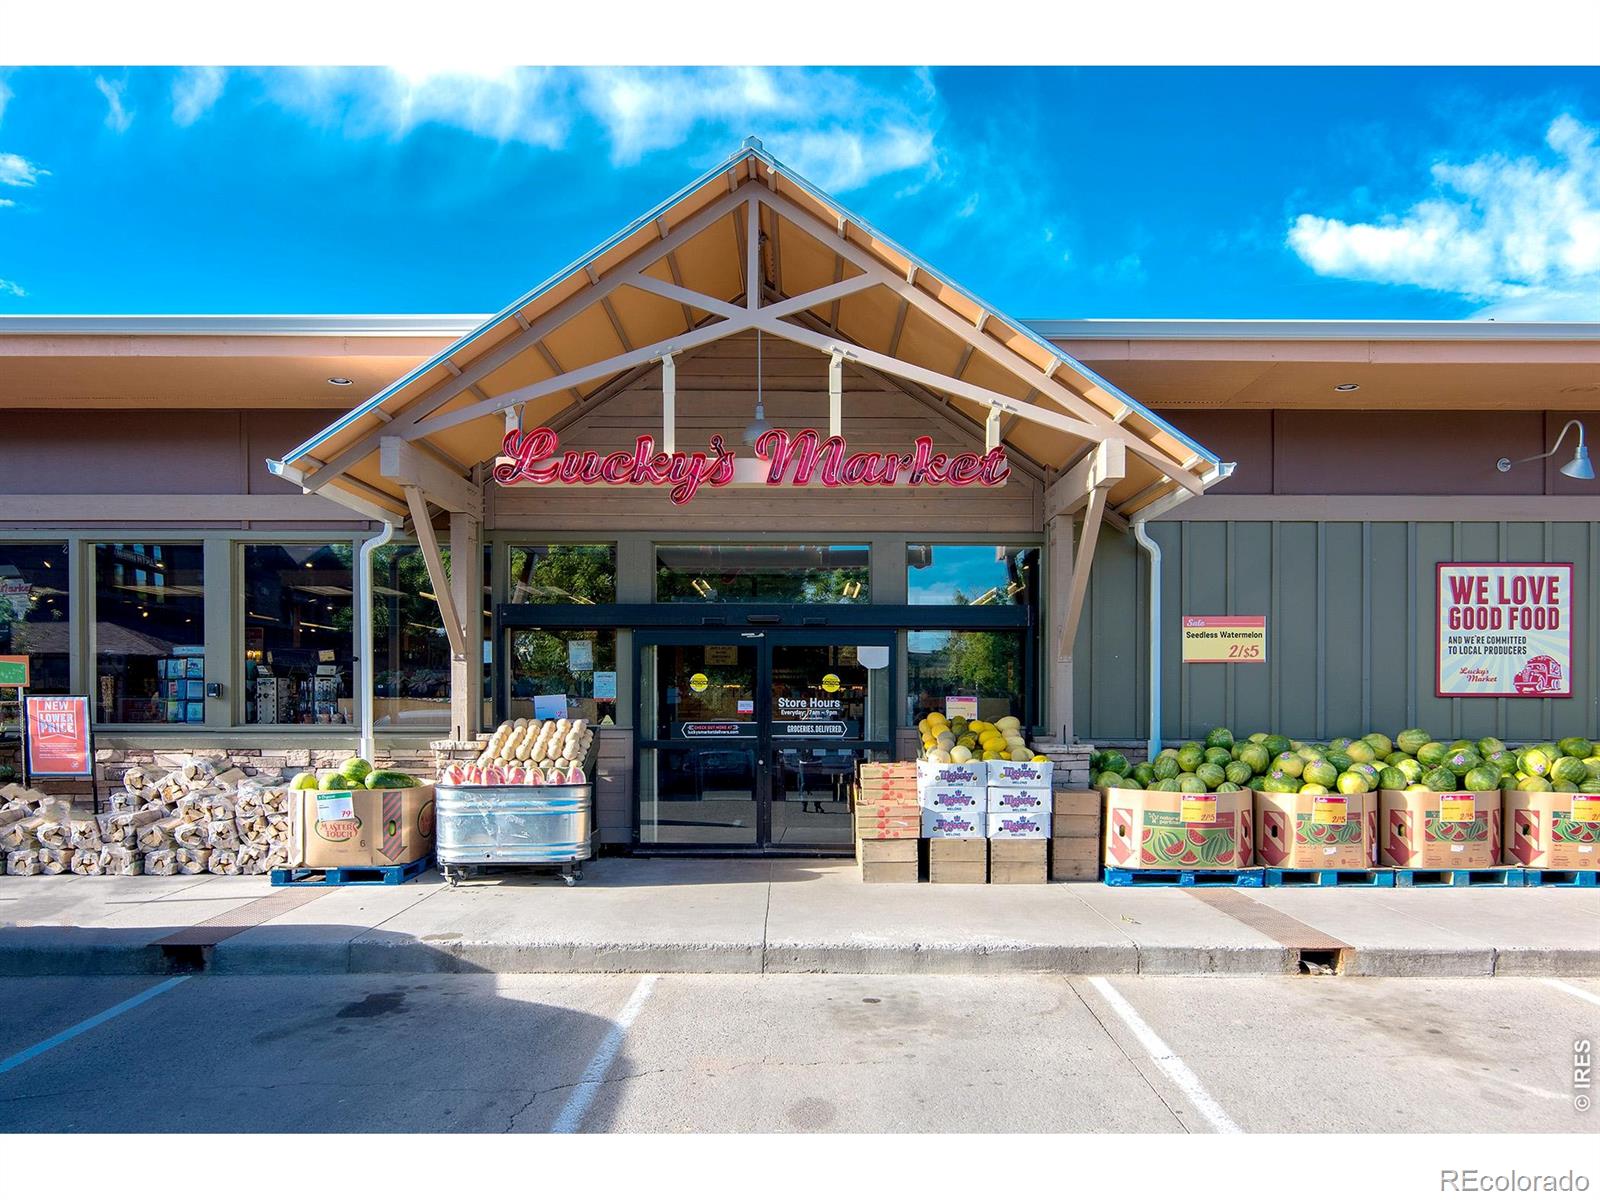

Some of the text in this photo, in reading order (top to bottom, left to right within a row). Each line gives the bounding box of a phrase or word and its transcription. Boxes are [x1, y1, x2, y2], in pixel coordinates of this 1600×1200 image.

[494, 427, 1011, 505] Lucky's Market
[1448, 575, 1560, 605] WE LOVE
[1186, 618, 1206, 628] Sale
[1448, 606, 1560, 631] GOOD FOOD
[1186, 631, 1263, 639] Seedless Watermelon
[1448, 635, 1527, 645] AND WE'RE COMMITTED
[1228, 644, 1260, 658] 2/$5
[1448, 646, 1527, 655] TO LOCAL PRODUCERS
[1459, 666, 1489, 675] Lucky's
[1466, 675, 1498, 683] Market
[44, 701, 69, 710] NEW
[778, 697, 841, 708] Store Hours
[39, 713, 74, 723] LOWER
[39, 722, 75, 733] PRICE
[360, 840, 366, 848] 6
